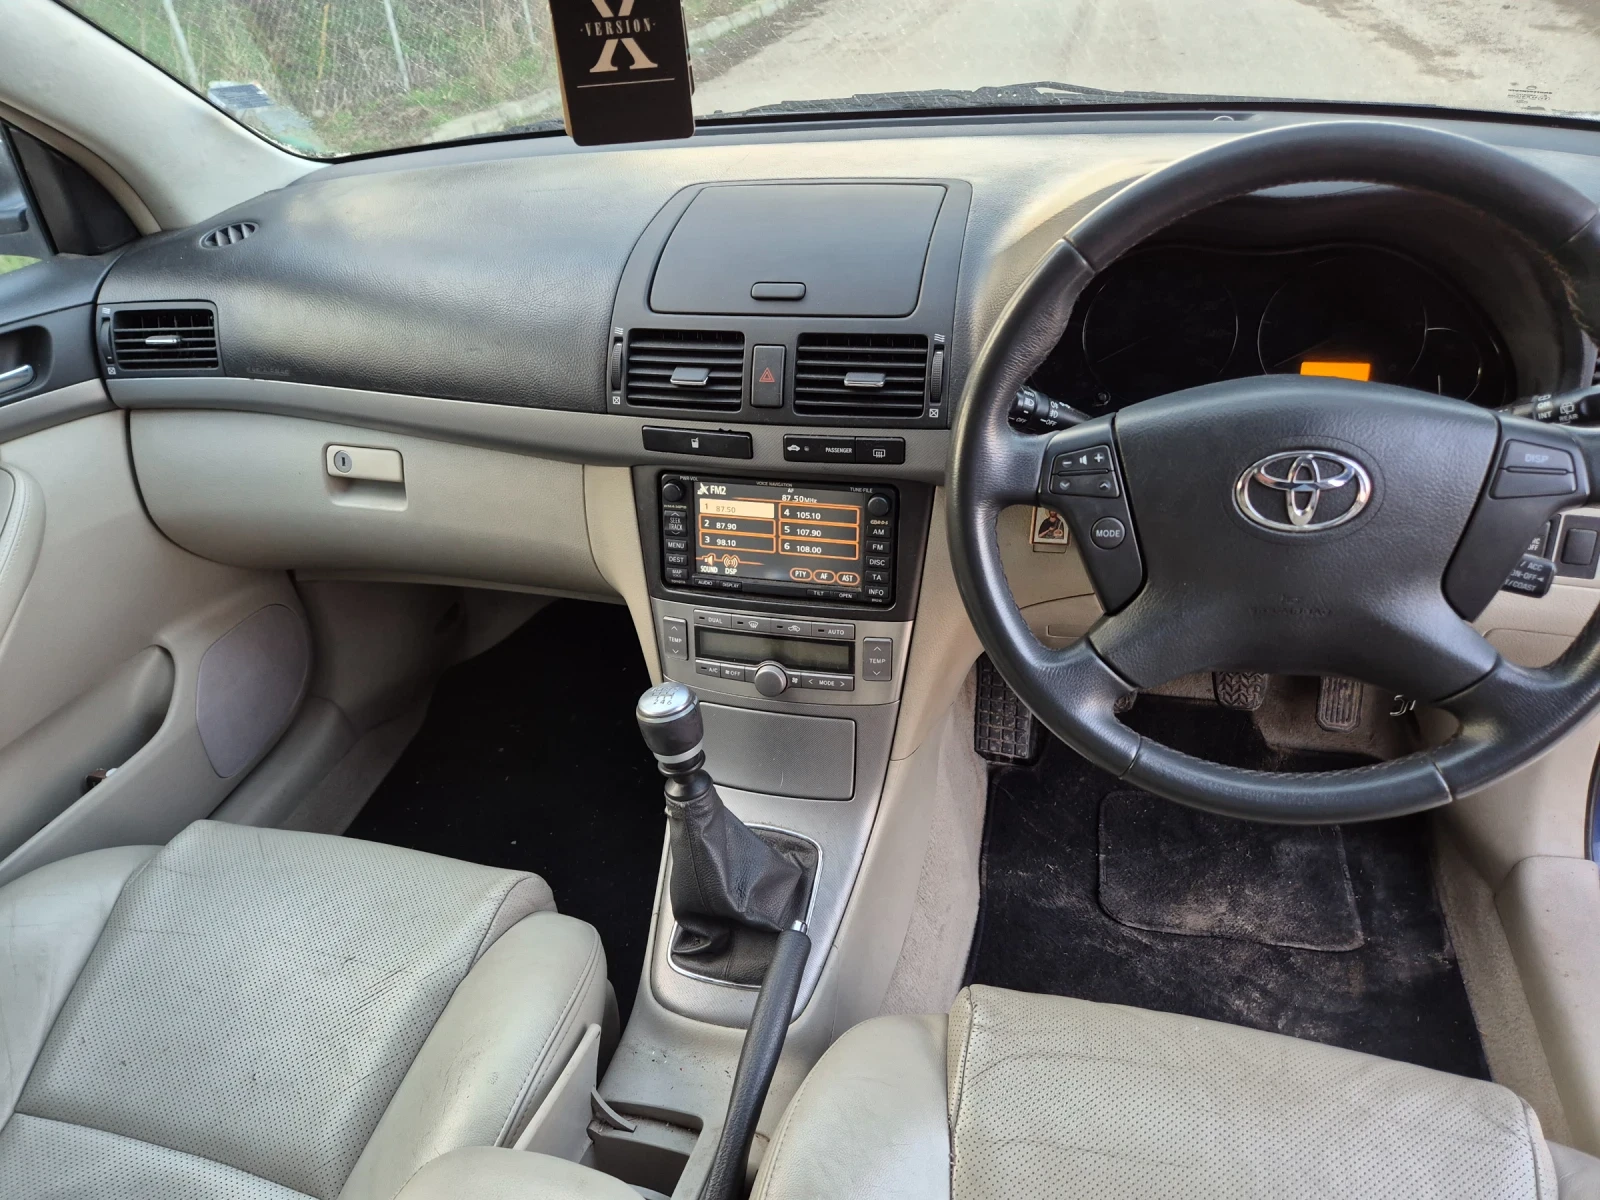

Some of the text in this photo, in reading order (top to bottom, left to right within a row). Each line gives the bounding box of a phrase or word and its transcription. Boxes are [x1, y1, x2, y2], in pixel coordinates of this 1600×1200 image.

[584, 18, 652, 36] VERSION
[1538, 401, 1552, 409] ON
[1538, 411, 1552, 420] INT
[1524, 453, 1550, 464] DISP
[710, 485, 726, 495] FM2
[796, 511, 821, 520] 105.10
[716, 522, 737, 530] 87.90
[796, 529, 821, 537] 107.90
[1096, 529, 1121, 538] MODE
[1527, 562, 1543, 571] ACC
